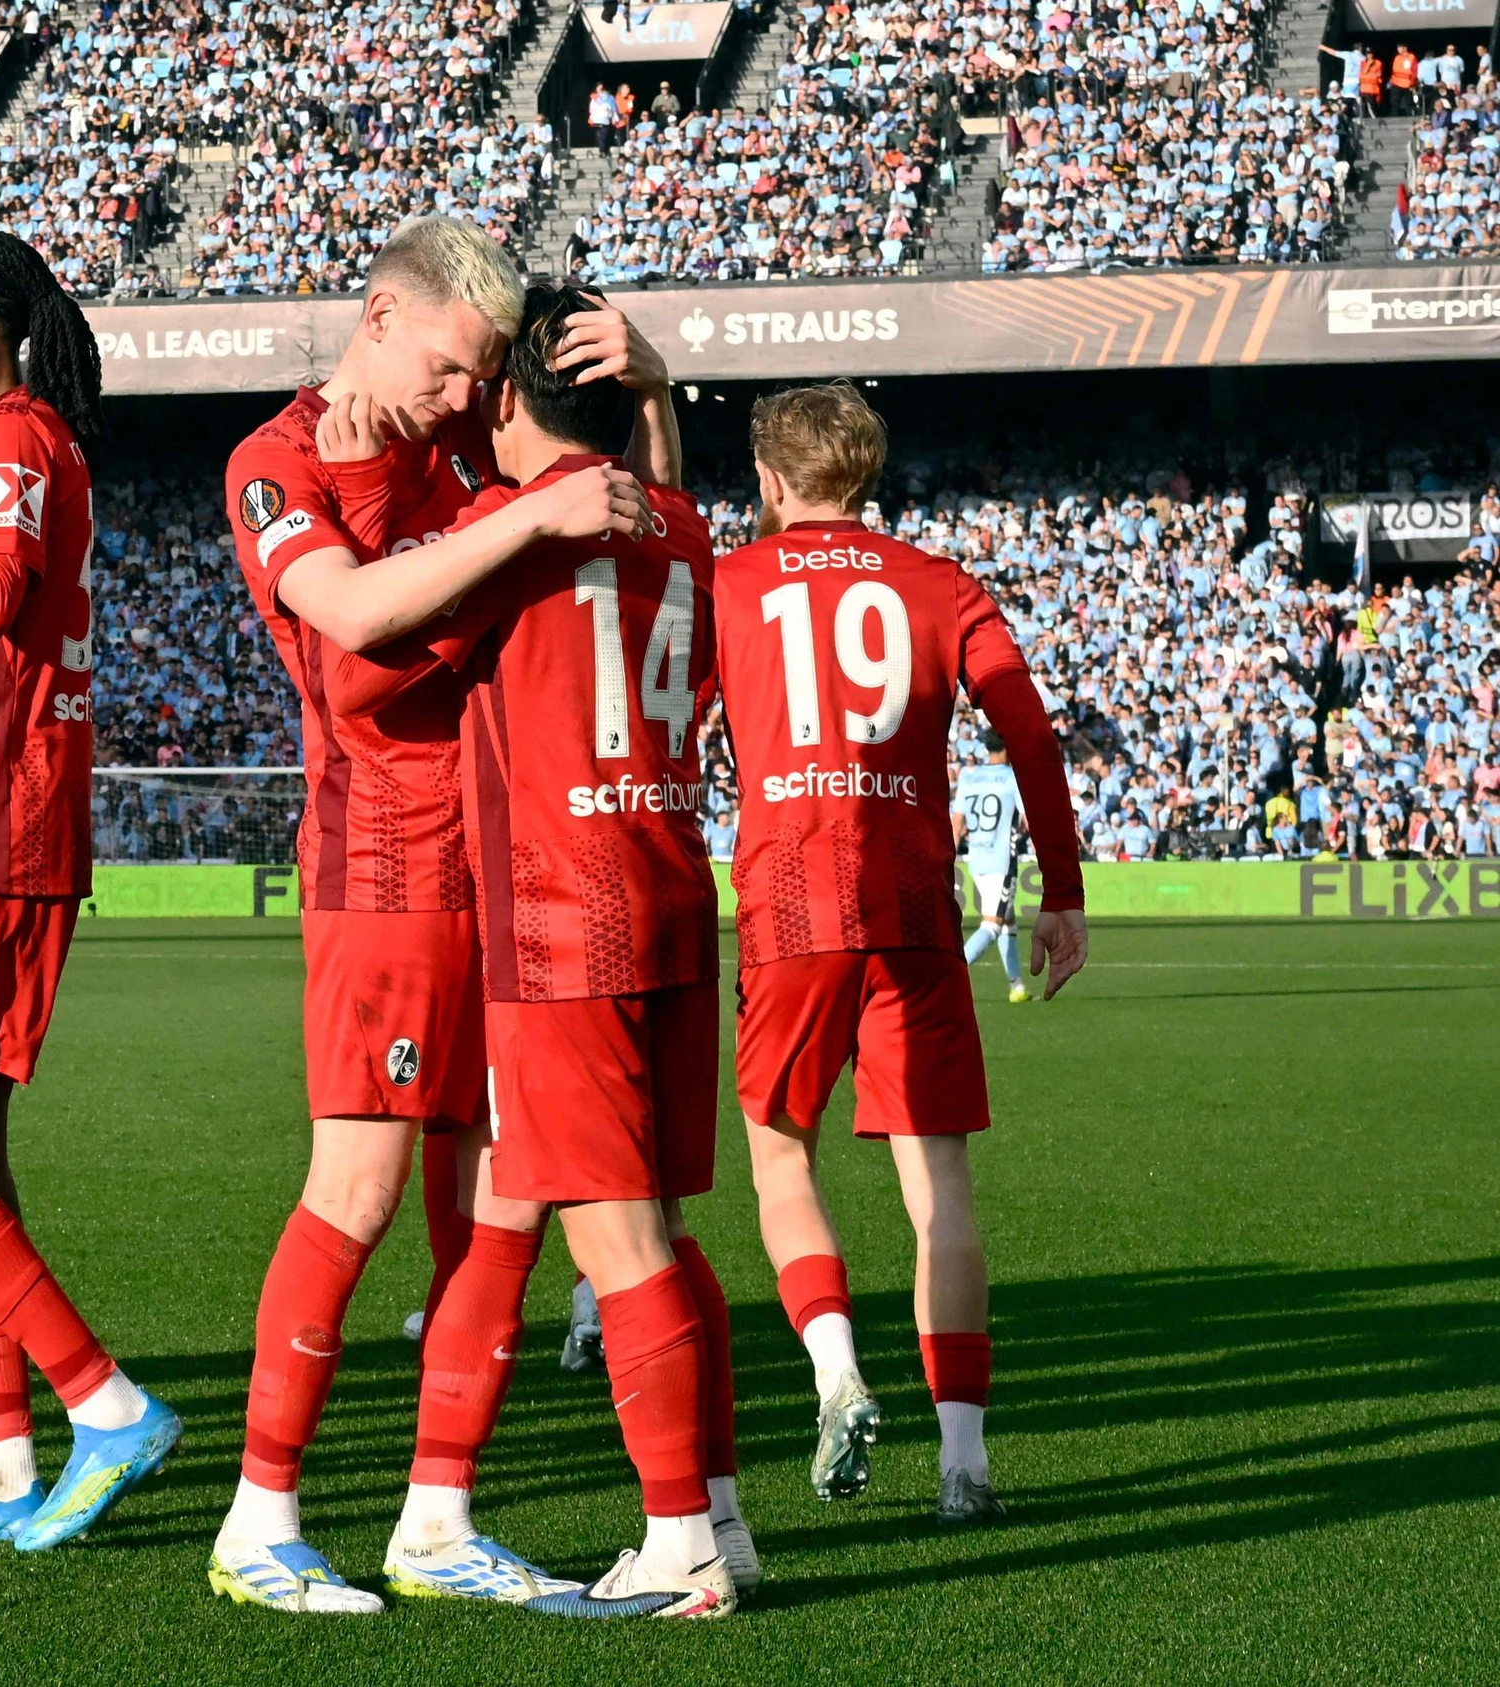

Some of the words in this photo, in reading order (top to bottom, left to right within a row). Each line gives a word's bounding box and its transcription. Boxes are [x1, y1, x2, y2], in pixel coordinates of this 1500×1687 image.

[147, 328, 275, 358] LEAGUE
[723, 308, 899, 345] STRAUSS
[778, 546, 883, 573] beste
[575, 558, 695, 758] 14
[760, 581, 912, 747] 19
[762, 762, 918, 806] scfreiburg
[965, 793, 1002, 833] 39
[403, 1547, 433, 1558] MILAN
